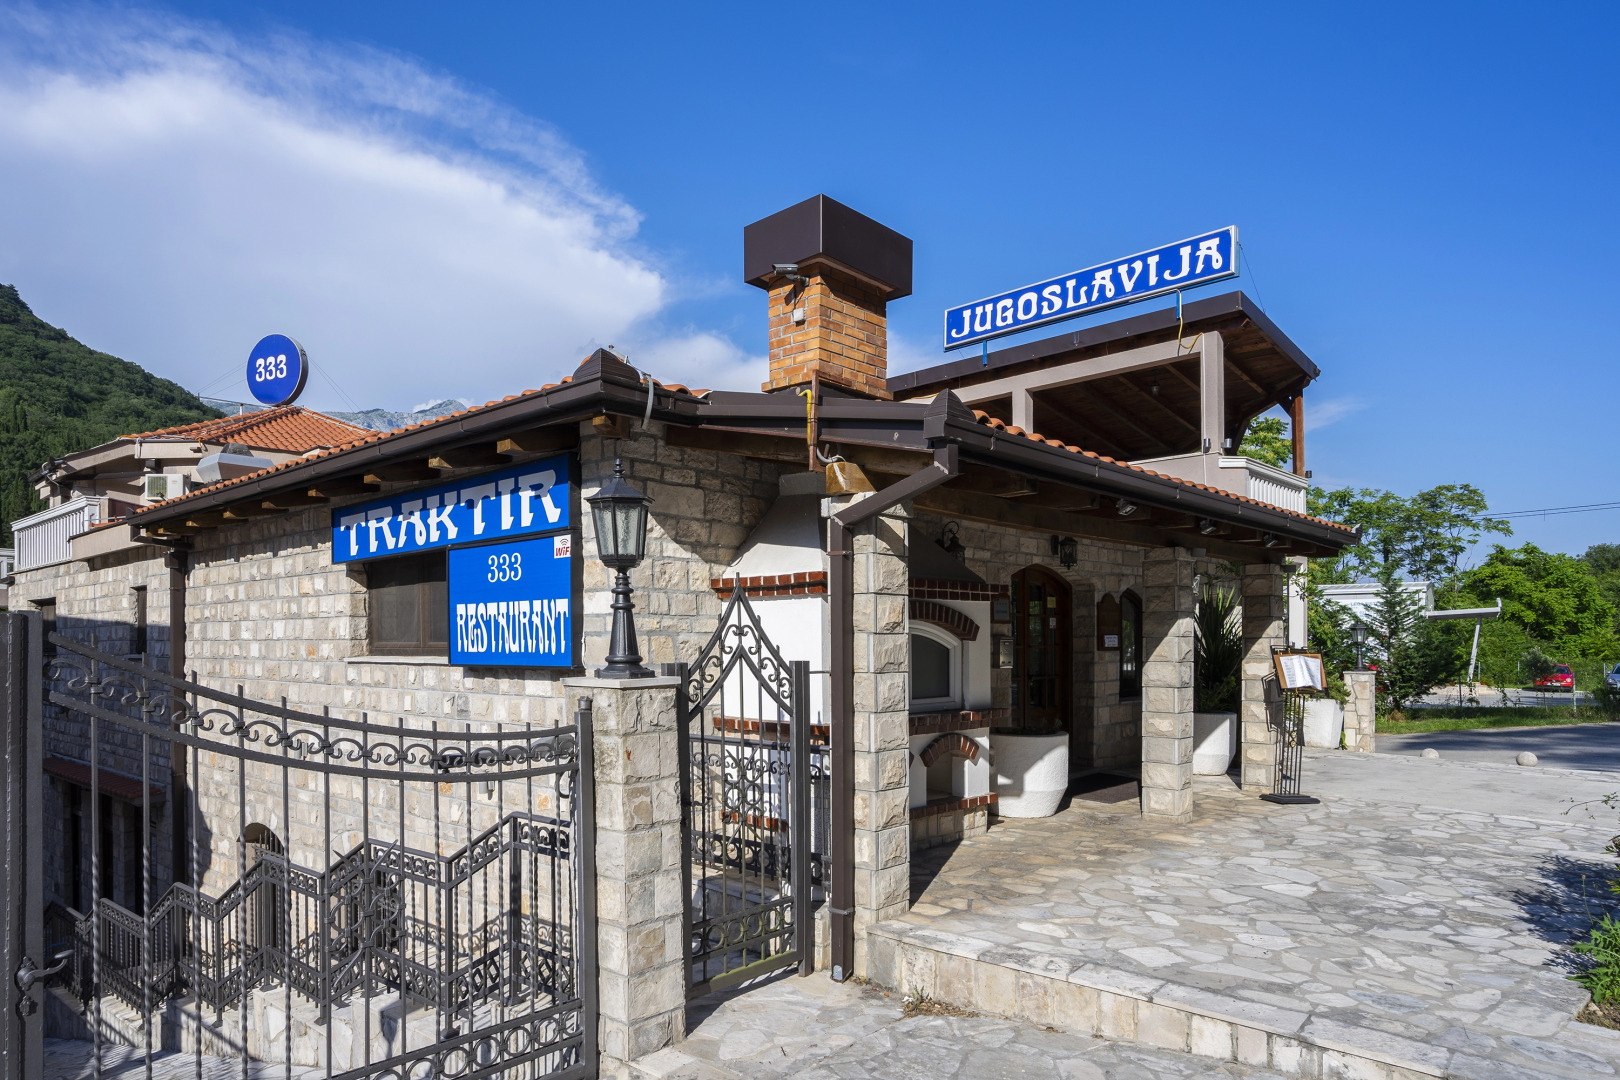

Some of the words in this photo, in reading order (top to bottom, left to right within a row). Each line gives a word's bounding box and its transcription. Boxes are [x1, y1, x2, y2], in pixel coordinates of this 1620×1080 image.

[950, 237, 1223, 338] JUGOSLAVIJA
[255, 354, 287, 382] 333
[340, 469, 561, 556] TRAKTIR
[487, 553, 522, 583] 333
[456, 598, 569, 656] RESTAURANT
